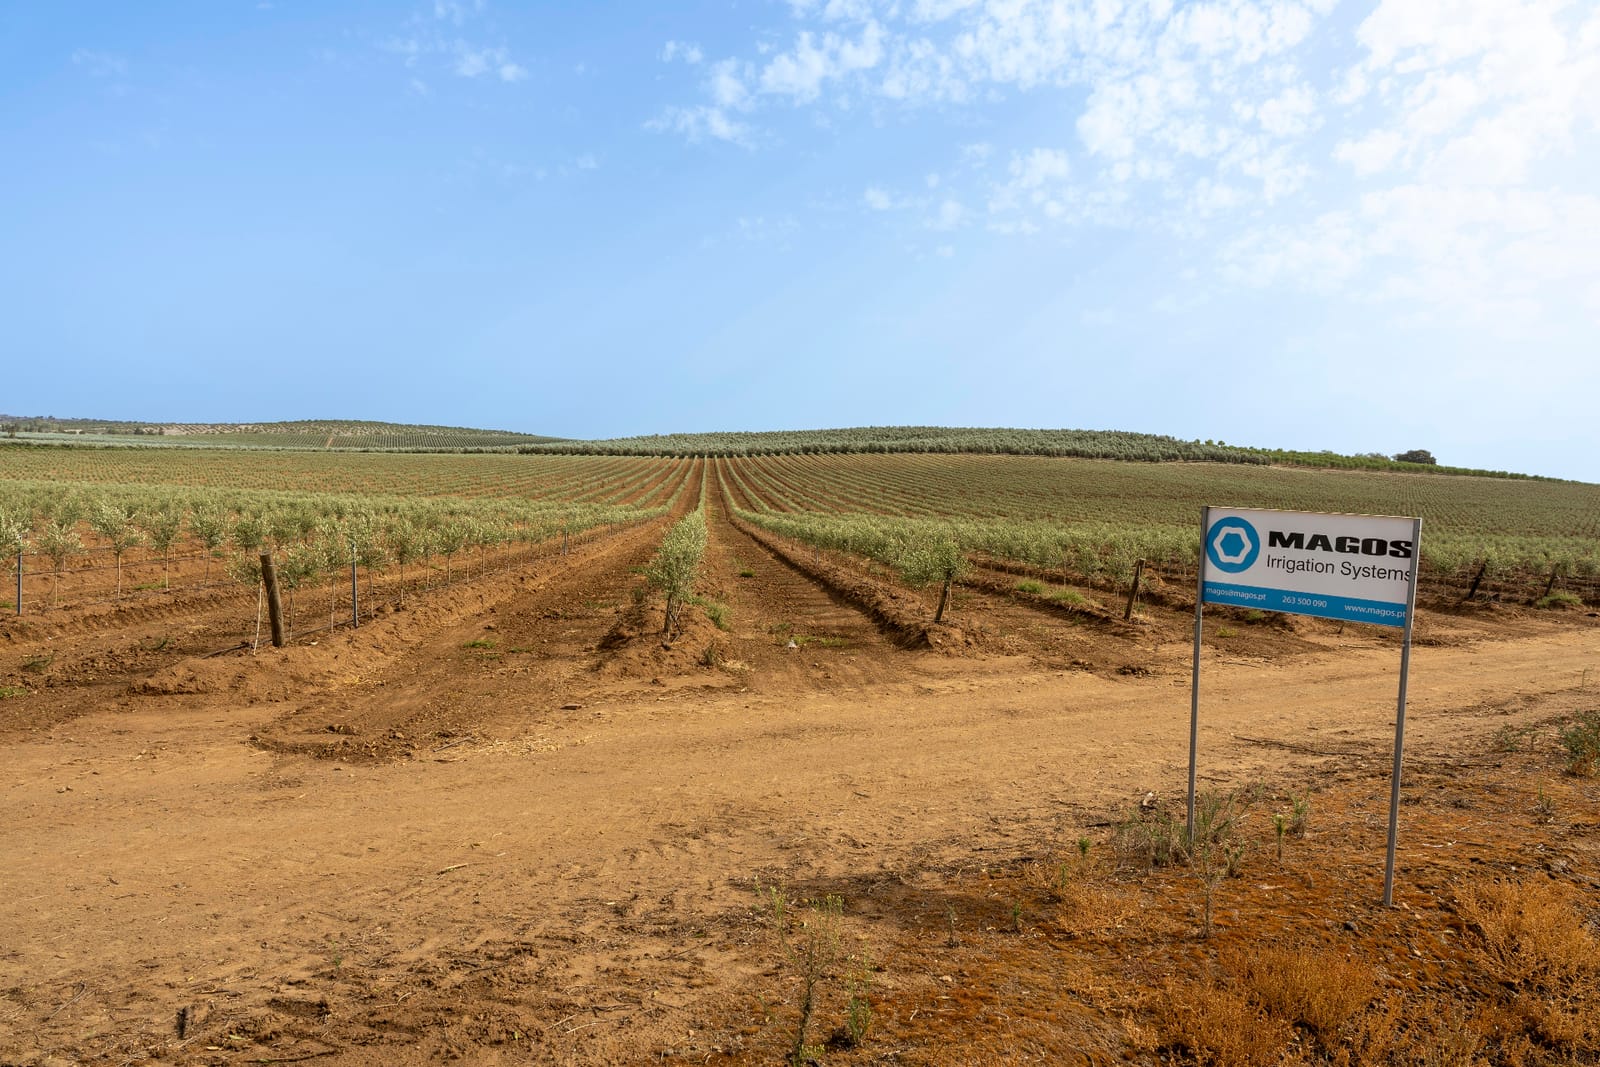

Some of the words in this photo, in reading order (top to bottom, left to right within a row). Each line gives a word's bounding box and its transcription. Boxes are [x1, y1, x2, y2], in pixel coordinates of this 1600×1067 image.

[1268, 531, 1413, 558] MAGOS
[1266, 554, 1335, 574] Irrigation
[1340, 561, 1411, 582] Systems
[1206, 587, 1266, 600] magos@magos.pt
[1282, 595, 1296, 604] 263
[1297, 597, 1311, 606] 500
[1312, 599, 1327, 608] 090
[1344, 604, 1406, 618] www.magos.pt
